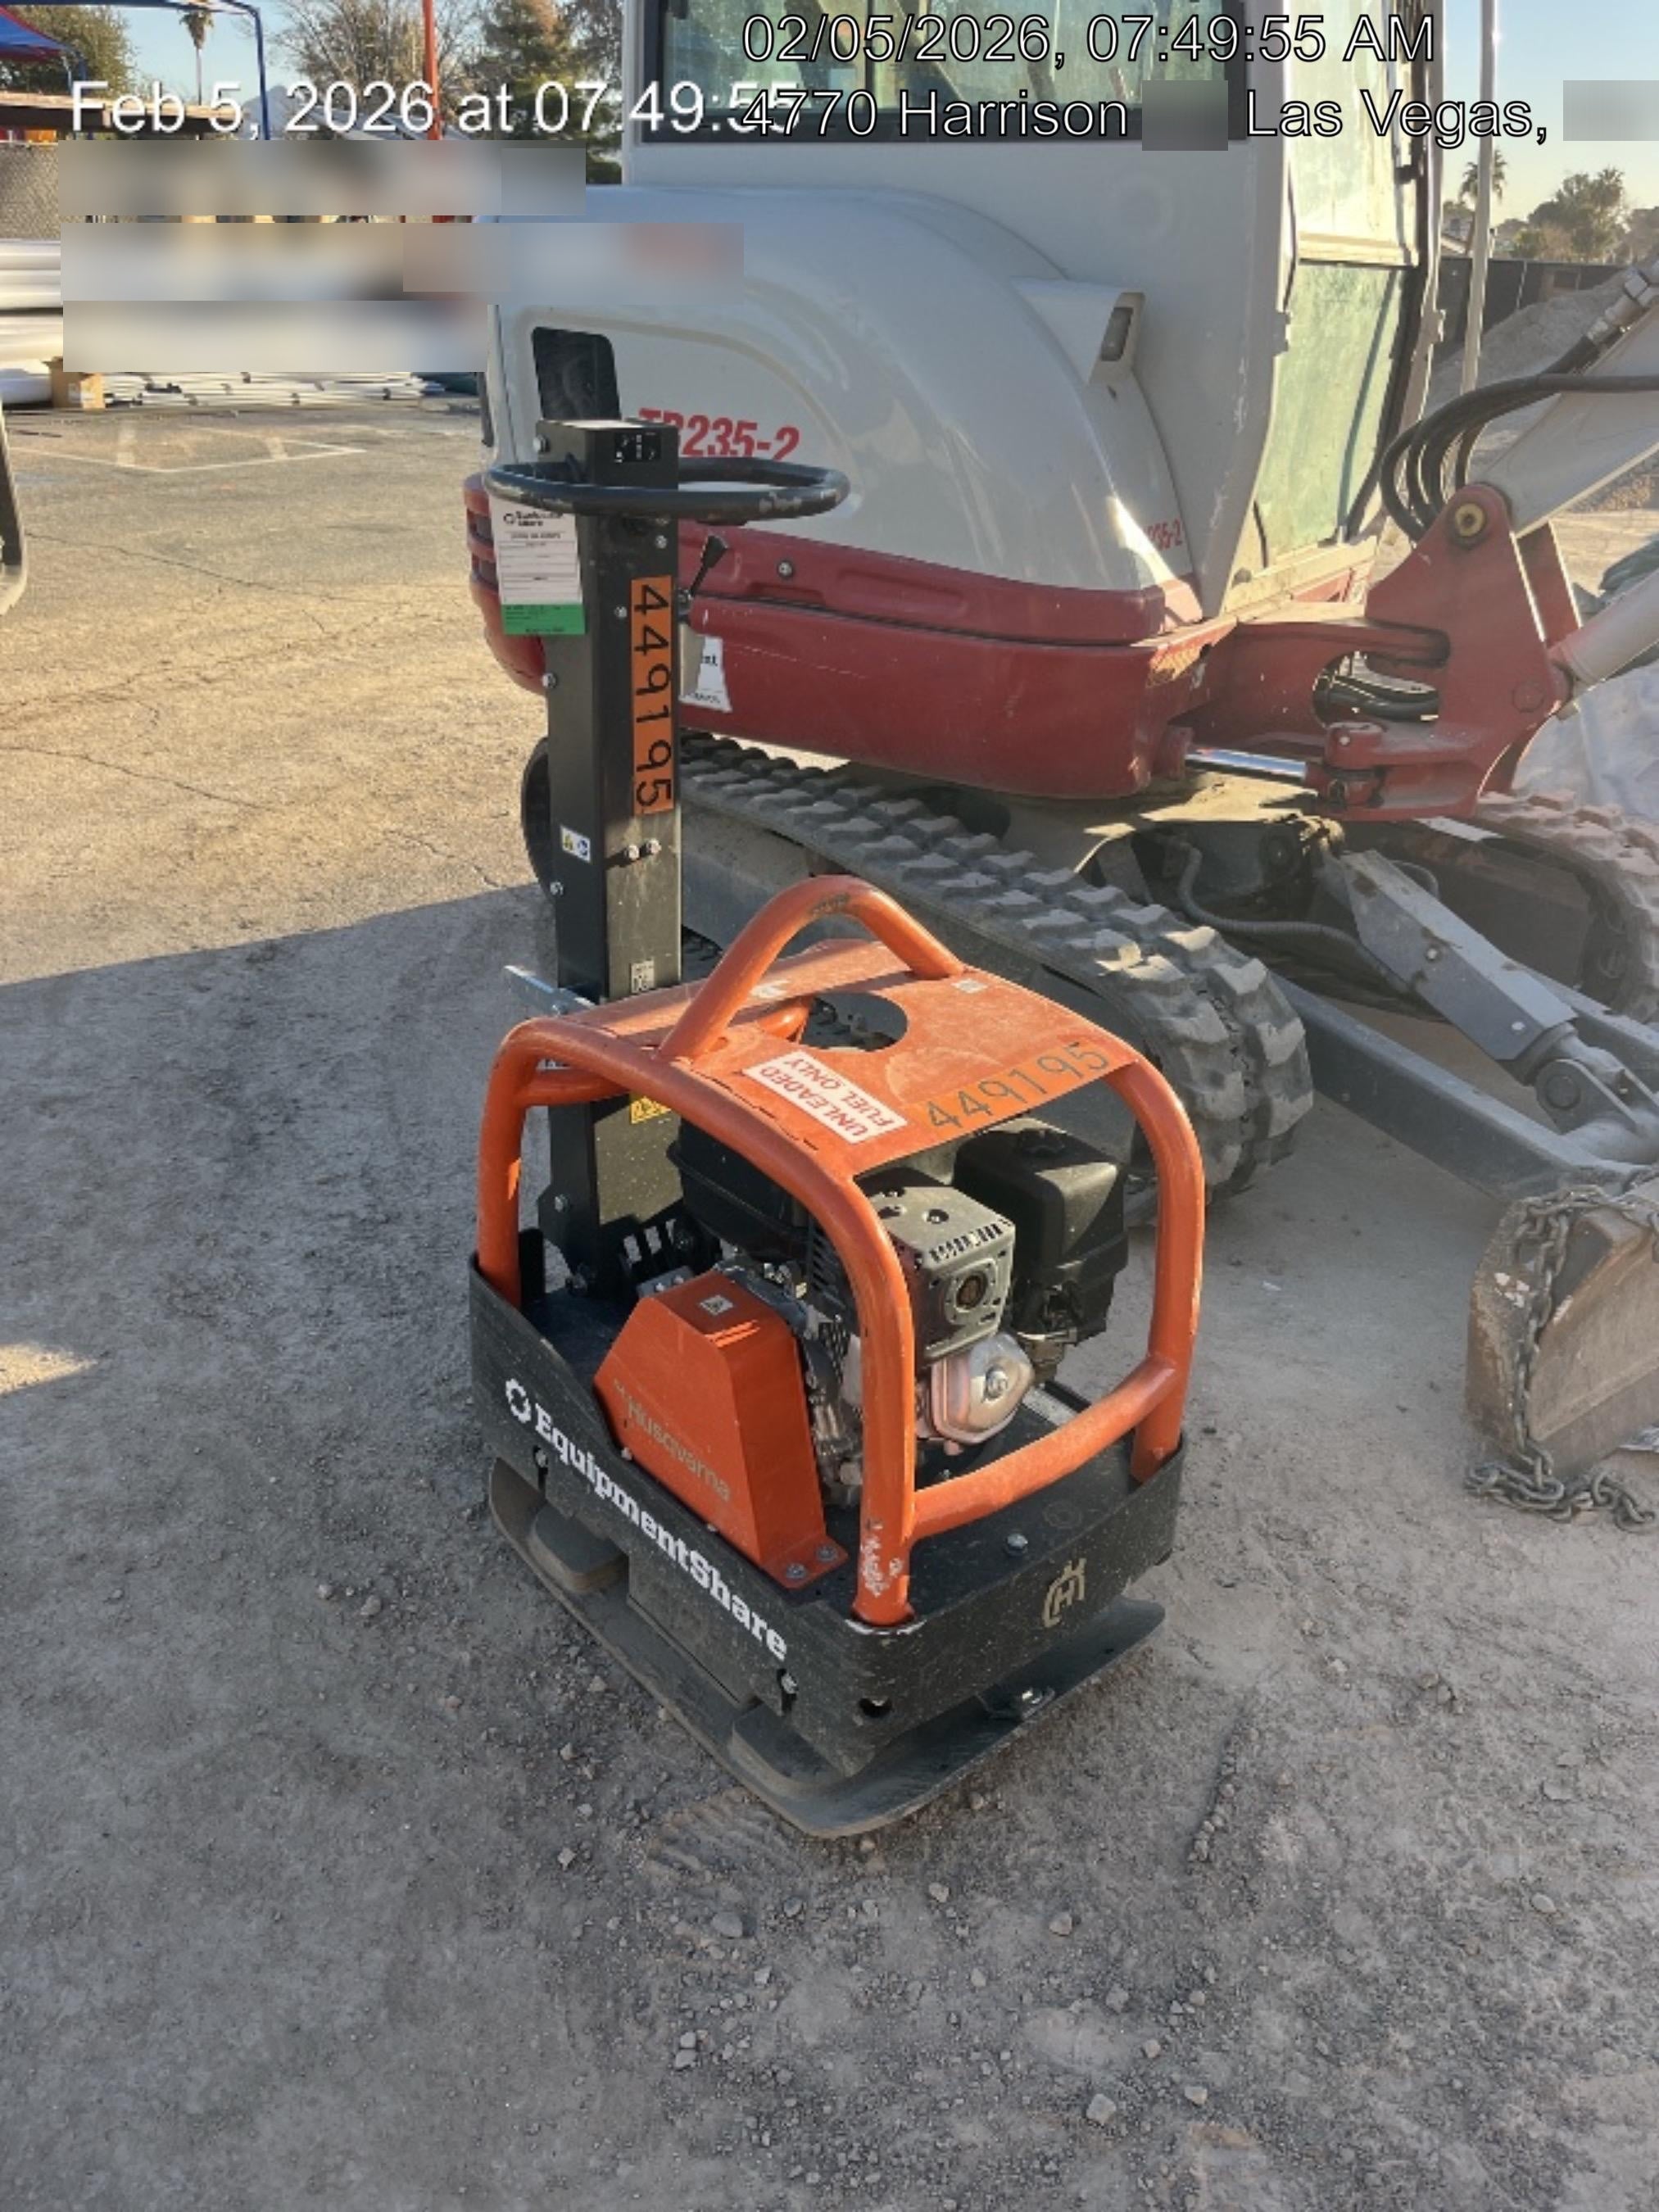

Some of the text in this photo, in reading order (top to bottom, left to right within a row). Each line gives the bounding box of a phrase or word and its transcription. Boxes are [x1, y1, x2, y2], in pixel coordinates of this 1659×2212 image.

[634, 584, 672, 807] 449195
[760, 1067, 868, 1136] UNLEADED
[784, 1058, 895, 1127] FUEL ONLY
[924, 1041, 1109, 1130] 449195
[535, 1403, 787, 1661] EquipmentShare
